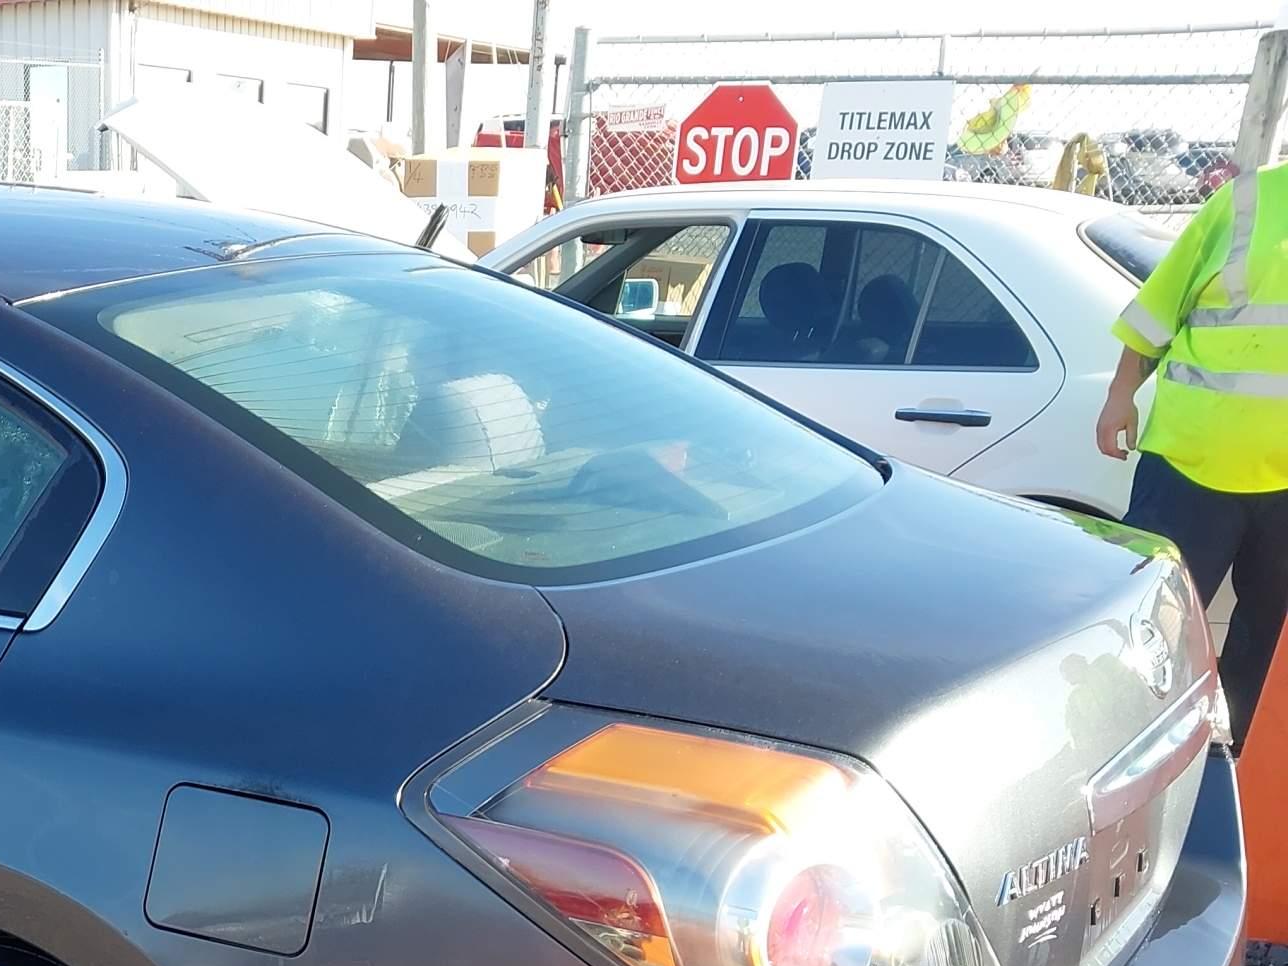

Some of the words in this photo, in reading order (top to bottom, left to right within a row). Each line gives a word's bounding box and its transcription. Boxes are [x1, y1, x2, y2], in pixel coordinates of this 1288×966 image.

[839, 111, 934, 130] TITLEMAX
[682, 126, 790, 176] STOP
[827, 142, 878, 161] DROP
[883, 142, 935, 160] ZONE
[995, 836, 1090, 907] ALTIMA
